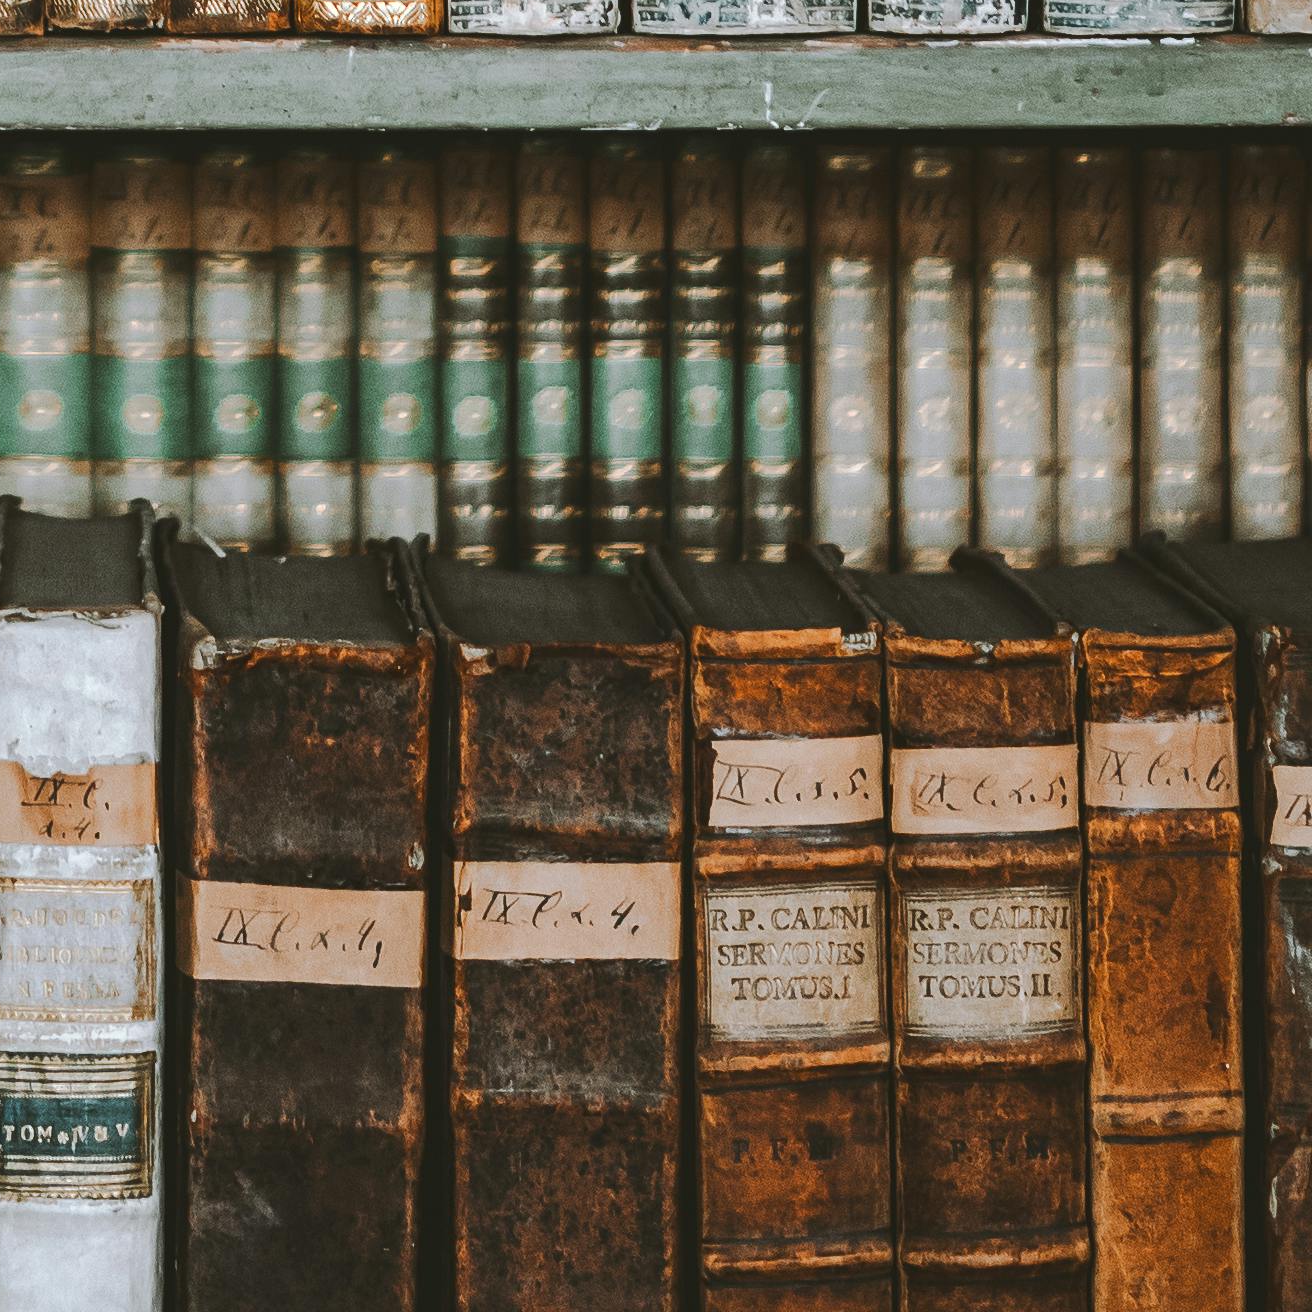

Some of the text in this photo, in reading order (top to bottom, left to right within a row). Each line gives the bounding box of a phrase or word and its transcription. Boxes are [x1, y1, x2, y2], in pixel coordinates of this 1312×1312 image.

[770, 904, 871, 931] CALINI
[969, 905, 1070, 930] CALINI
[717, 941, 866, 968] SERMONES
[912, 941, 1063, 966] SERMONES
